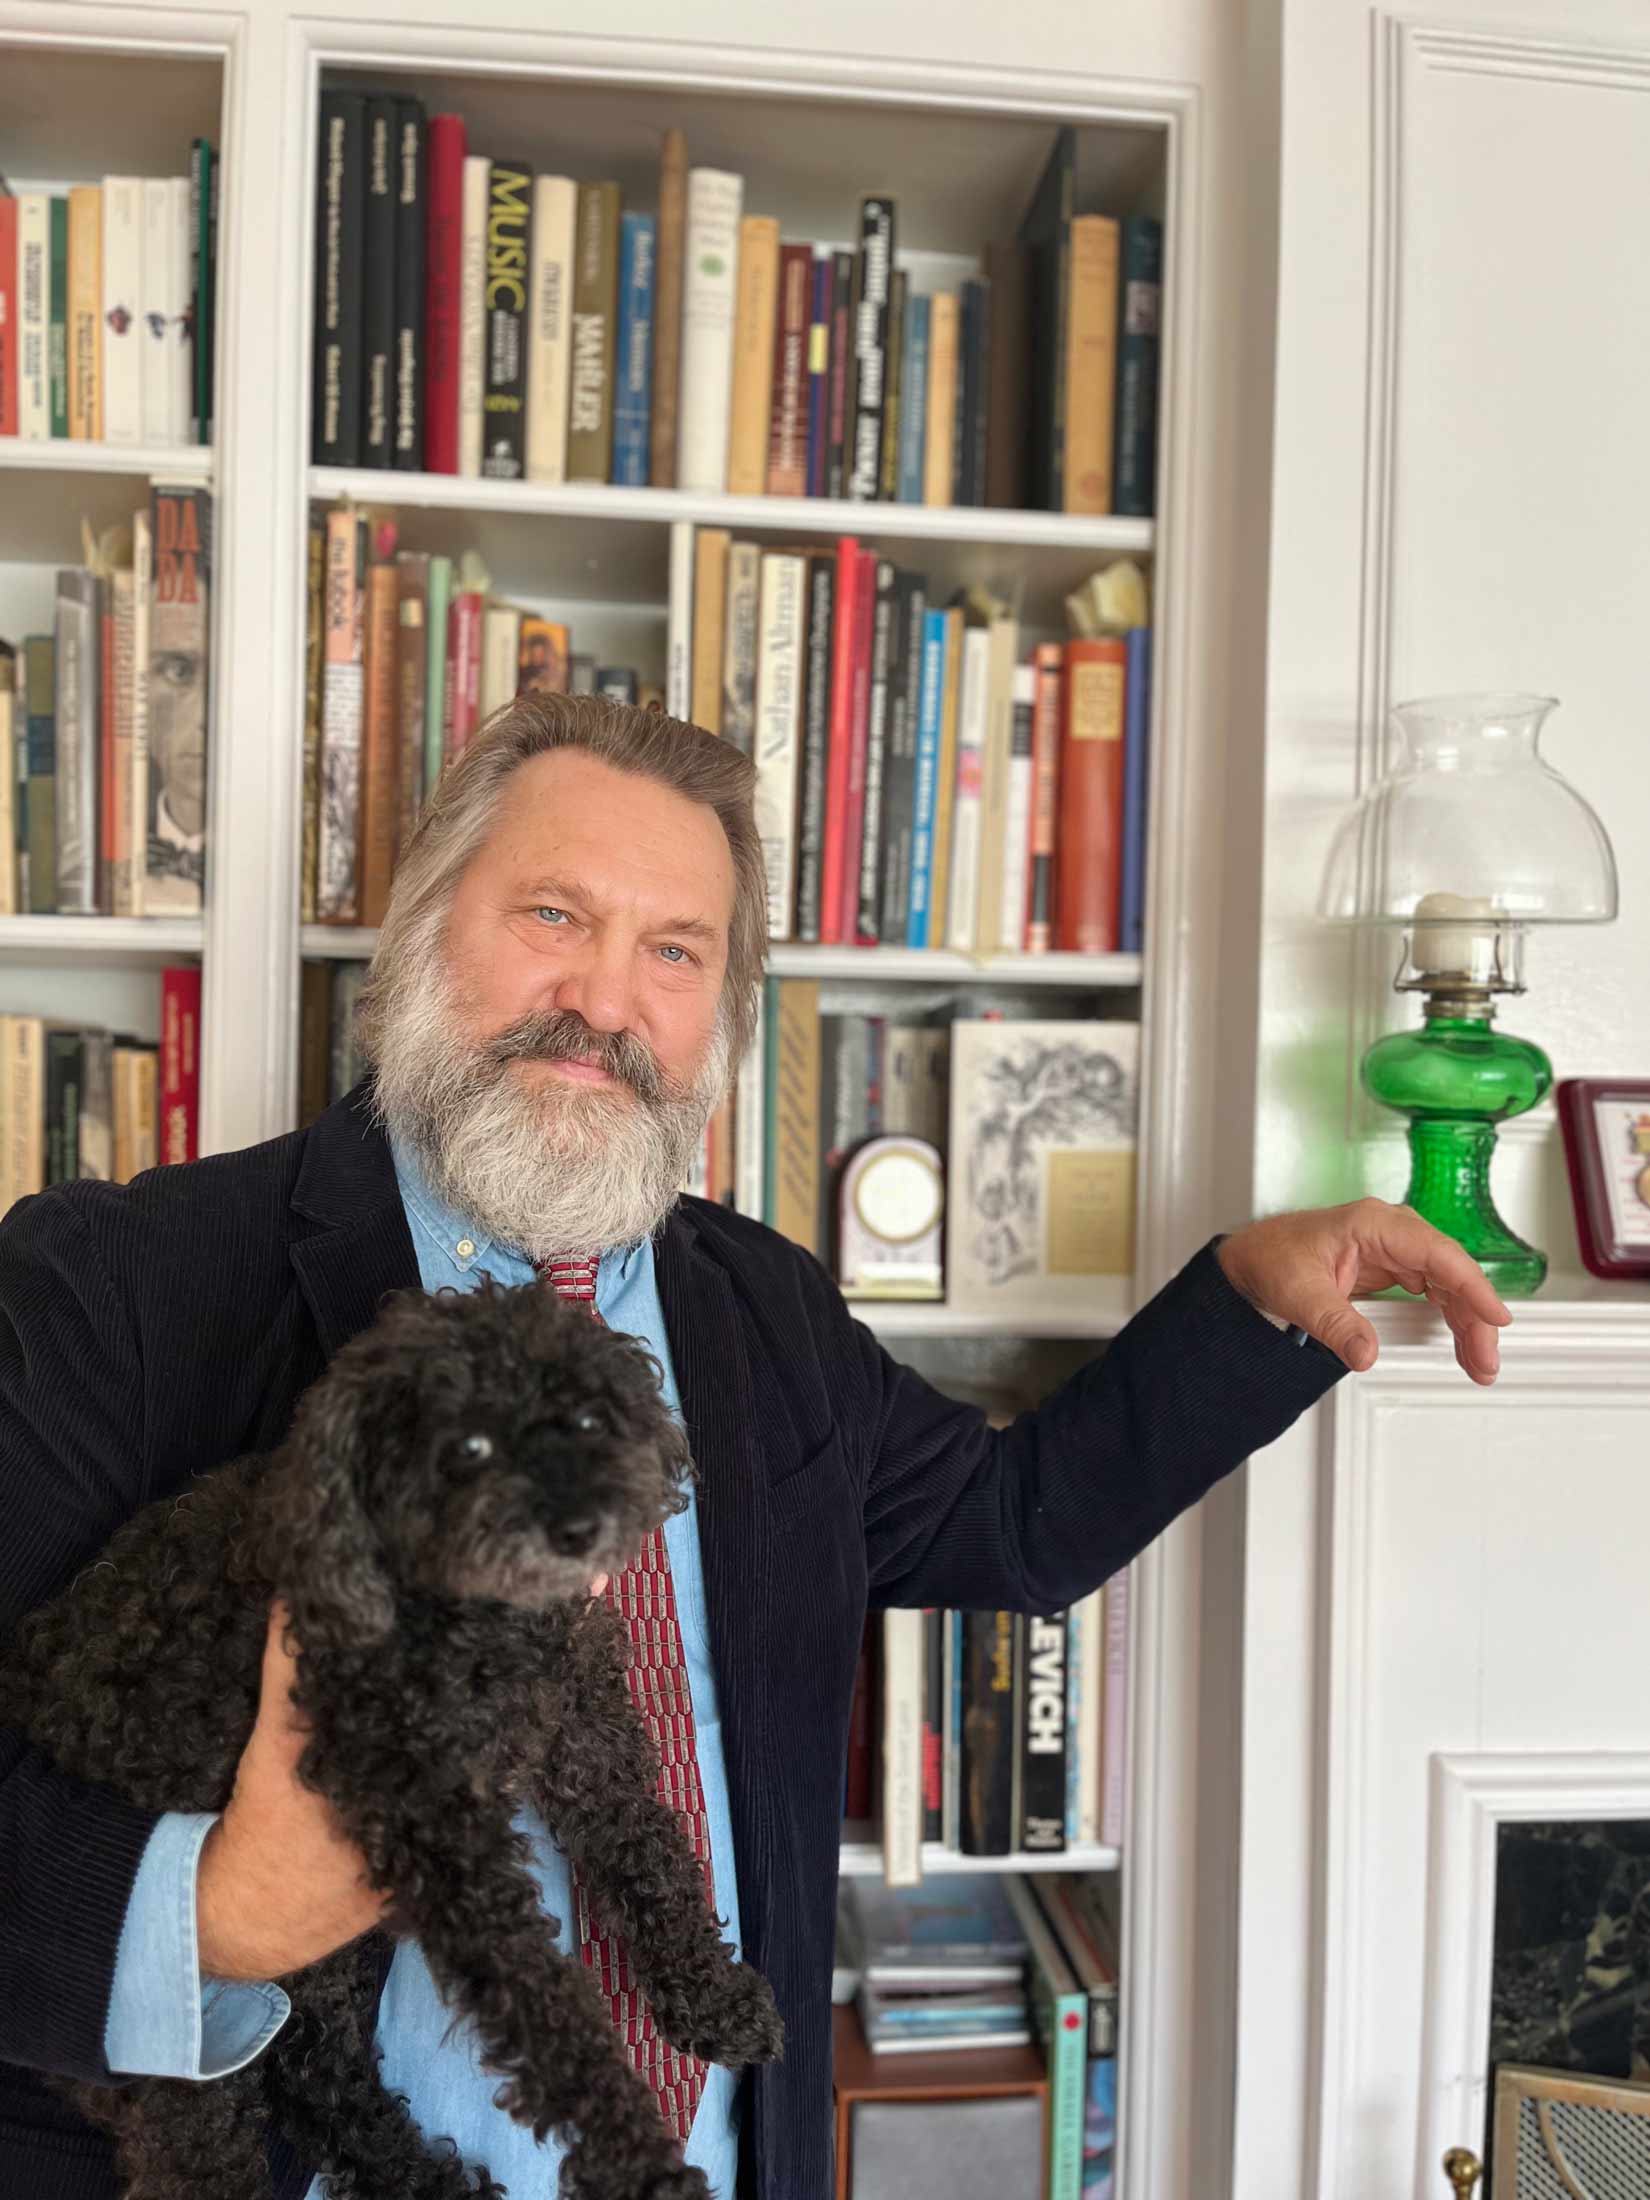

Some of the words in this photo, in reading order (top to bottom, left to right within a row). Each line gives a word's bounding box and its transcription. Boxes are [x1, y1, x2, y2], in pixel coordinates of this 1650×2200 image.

[486, 168, 533, 313] MUSIC
[572, 313, 605, 432] MAHLER
[156, 498, 201, 552] DA
[156, 551, 199, 604] DA
[763, 663, 793, 761] Nathan
